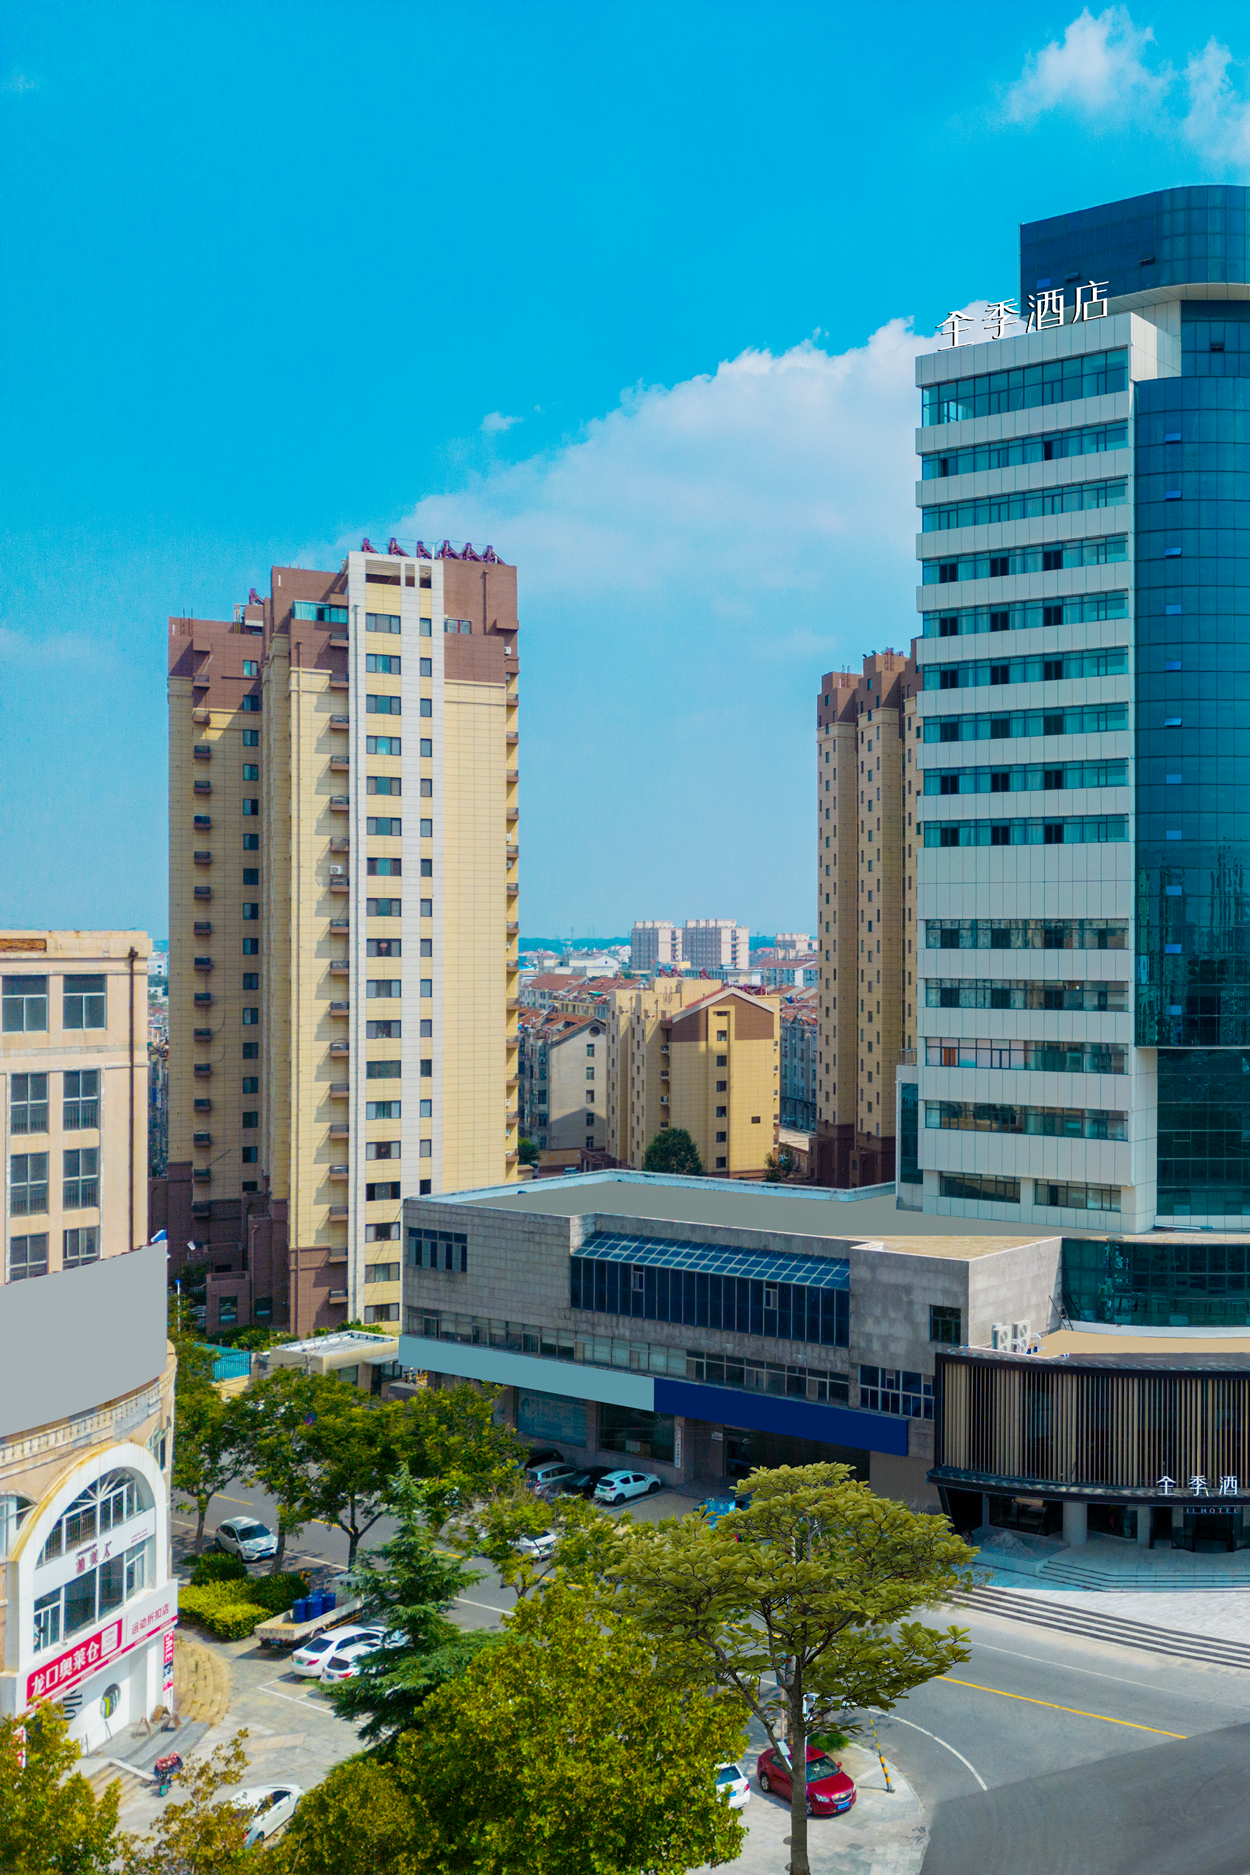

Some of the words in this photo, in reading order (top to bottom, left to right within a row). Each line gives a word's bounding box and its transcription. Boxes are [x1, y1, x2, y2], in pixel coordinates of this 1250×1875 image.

[936, 280, 1110, 352] 全季酒店
[131, 1603, 170, 1636] 运动折扣店
[165, 1632, 174, 1661] SALE
[31, 1641, 100, 1697] 龙口奥莱仓
[63, 1689, 83, 1721] llo
